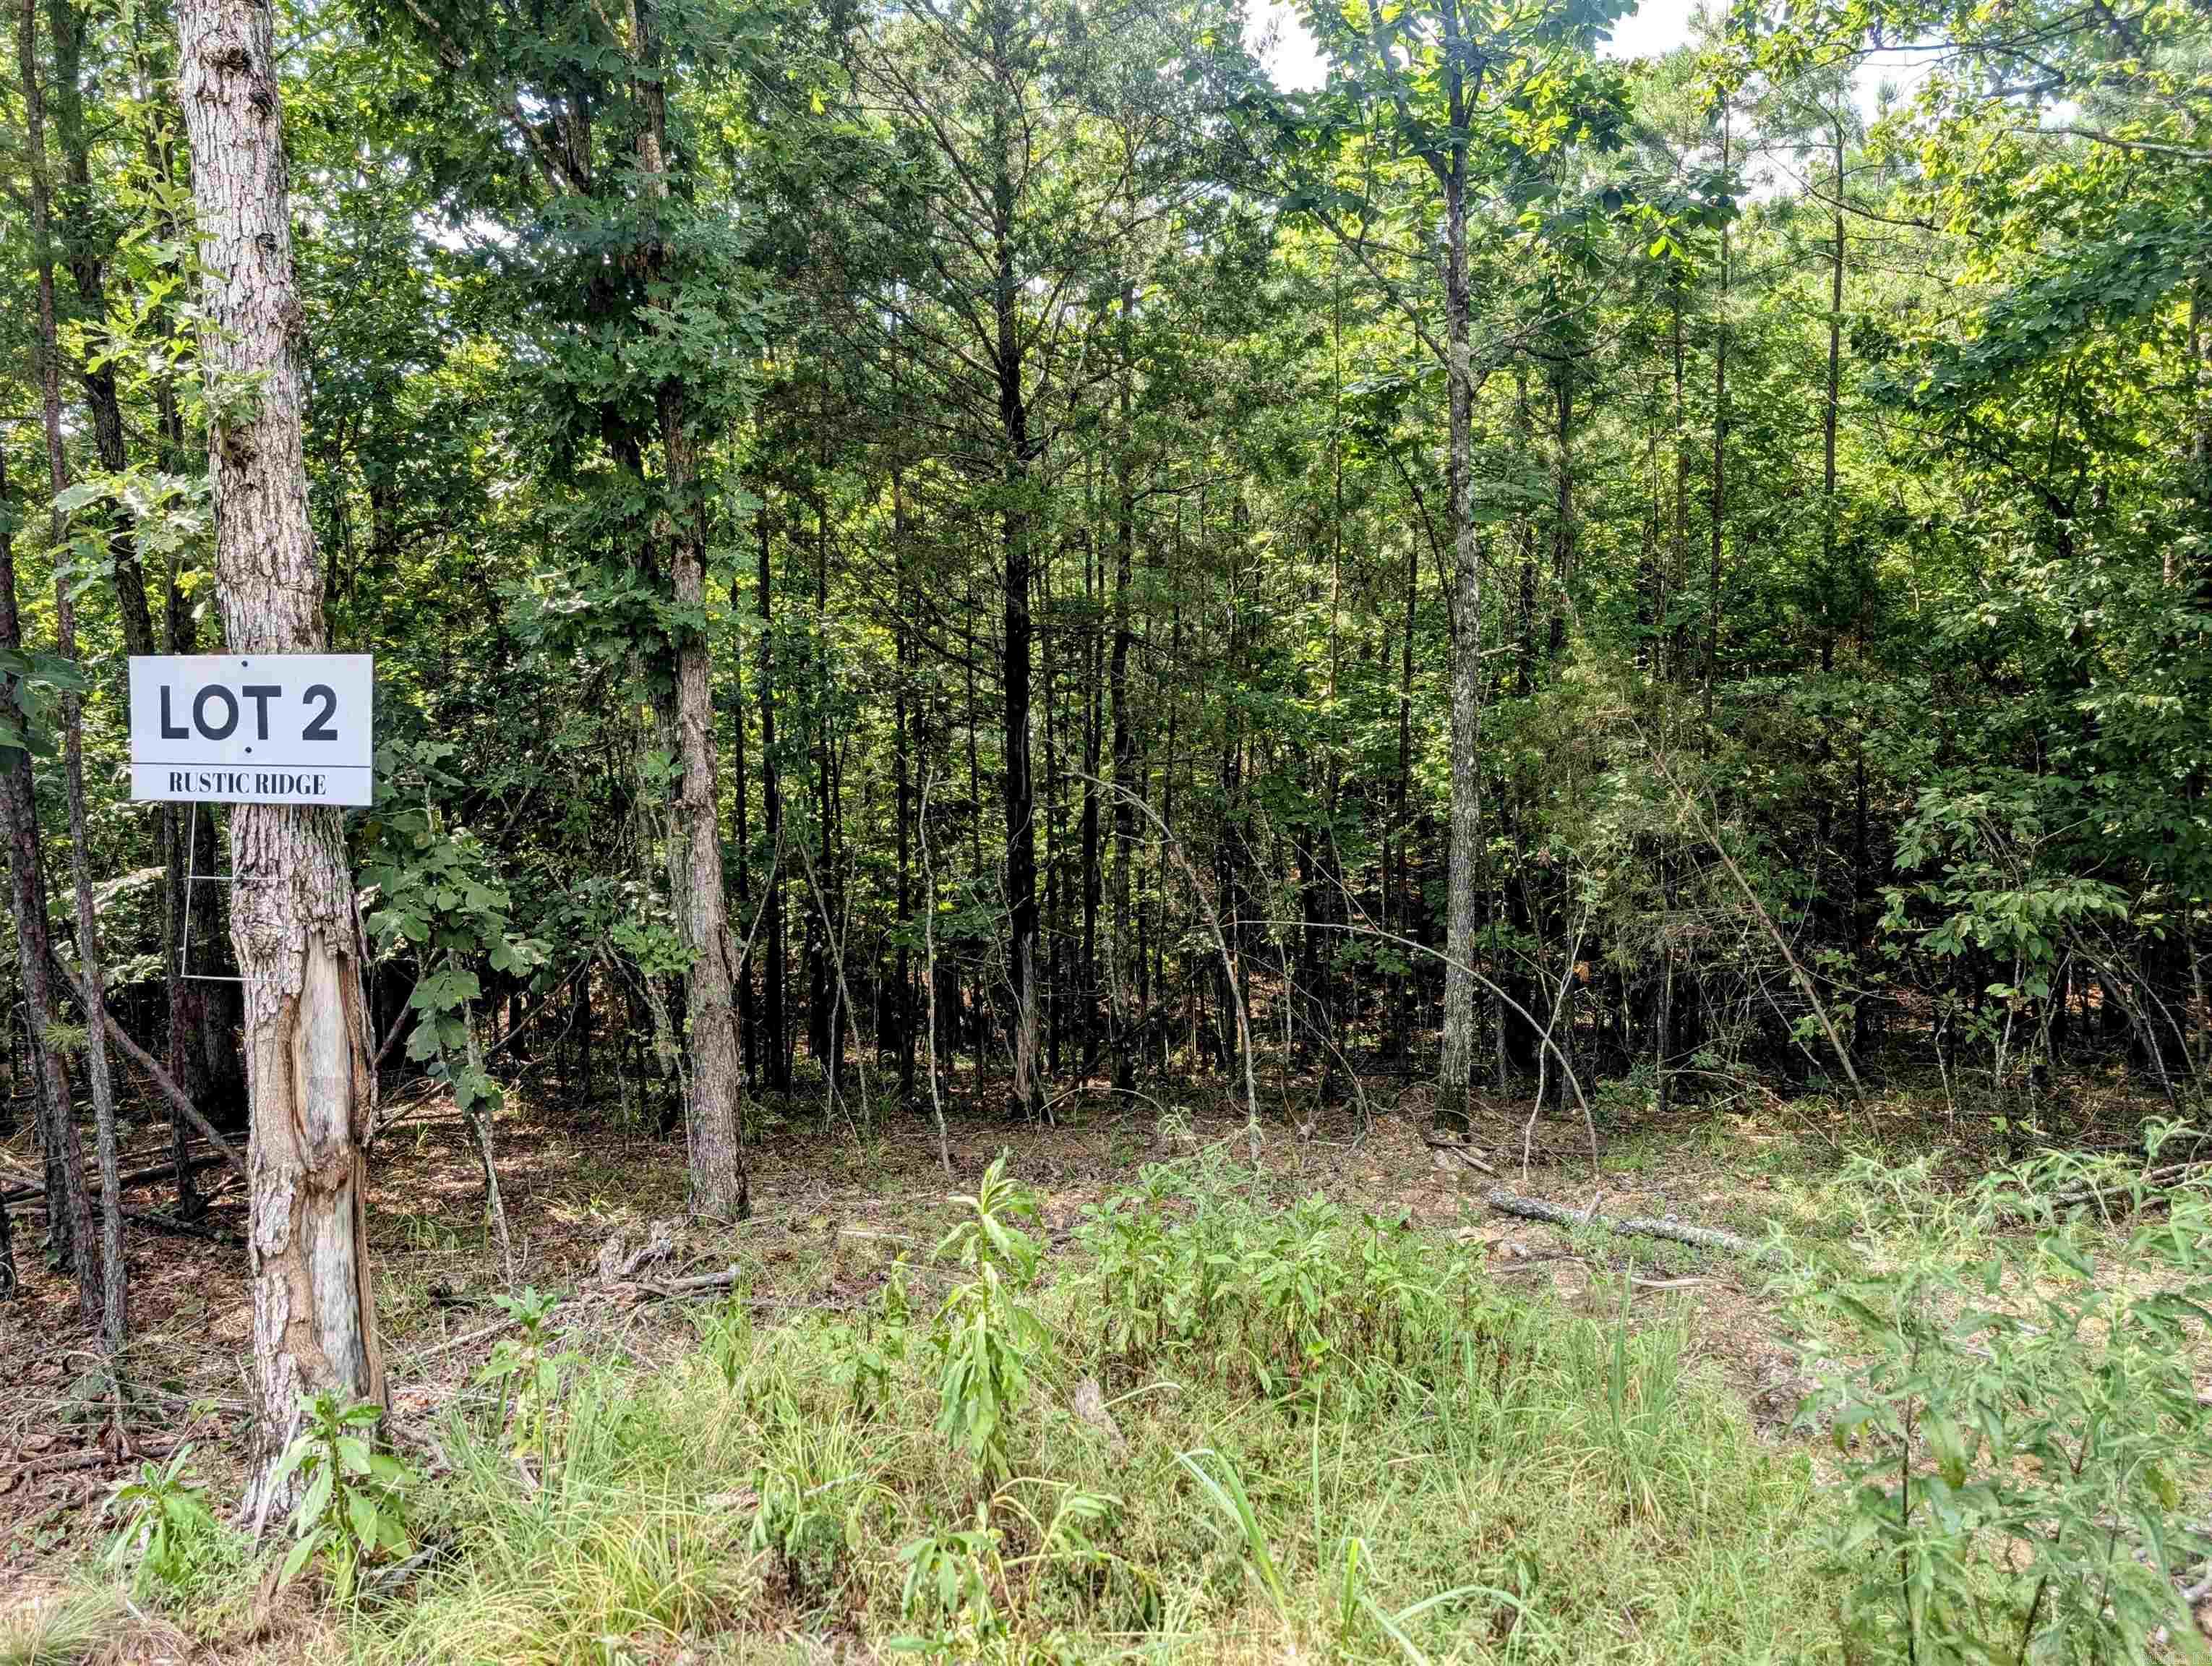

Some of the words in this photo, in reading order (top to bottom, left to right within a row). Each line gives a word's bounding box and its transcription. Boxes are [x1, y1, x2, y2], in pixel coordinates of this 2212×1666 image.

[160, 684, 282, 741] LOT
[302, 684, 338, 741] 2
[169, 772, 249, 793] RUSTIC
[254, 774, 326, 795] RIDGE
